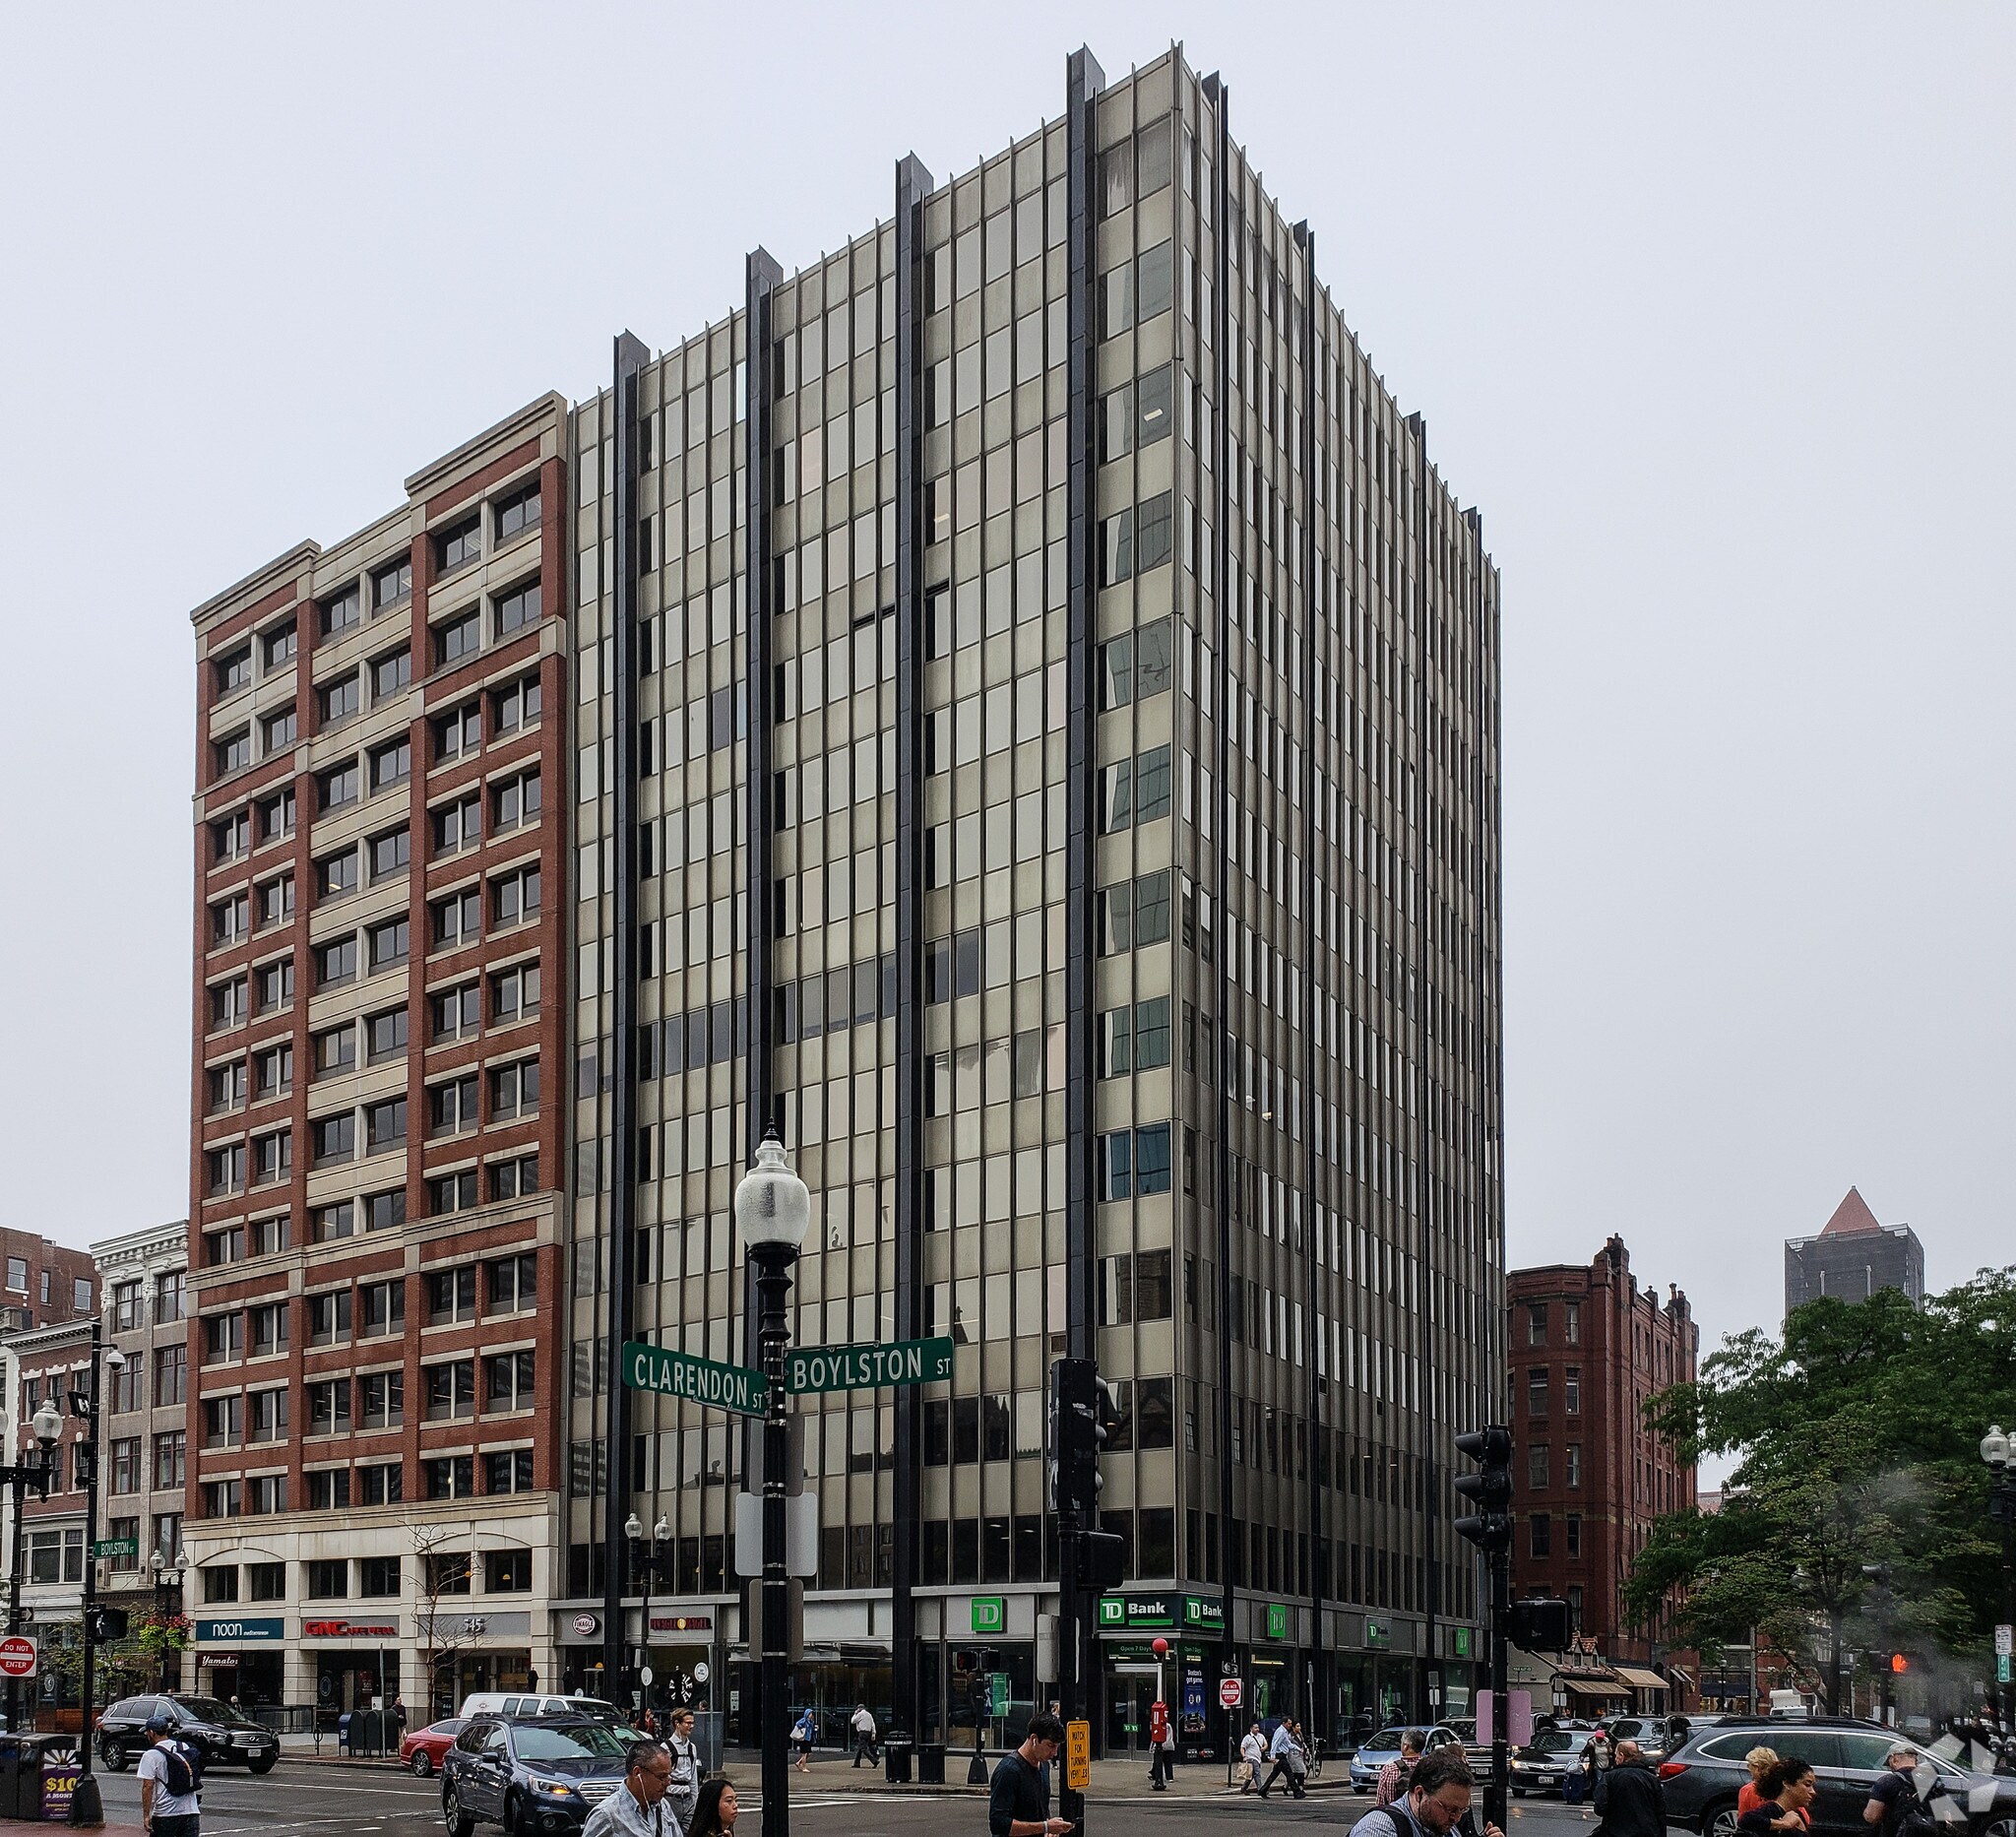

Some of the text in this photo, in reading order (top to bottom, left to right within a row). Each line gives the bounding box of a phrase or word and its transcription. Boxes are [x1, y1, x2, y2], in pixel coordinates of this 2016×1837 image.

[793, 1347, 951, 1390] BOYLSTON ST
[634, 1354, 763, 1410] CLARENDON ST
[100, 1542, 129, 1555] BOYLSTON
[975, 1604, 998, 1624] TD
[1102, 1602, 1166, 1619] TD Bank
[1188, 1602, 1223, 1619] TD Bank
[213, 1623, 242, 1636] noon
[305, 1621, 346, 1635] GNC
[1072, 1732, 1085, 1741] WATCH
[1071, 1756, 1086, 1767] TURNING
[1071, 1769, 1087, 1780] VEHLES
[45, 1777, 77, 1792] $10
